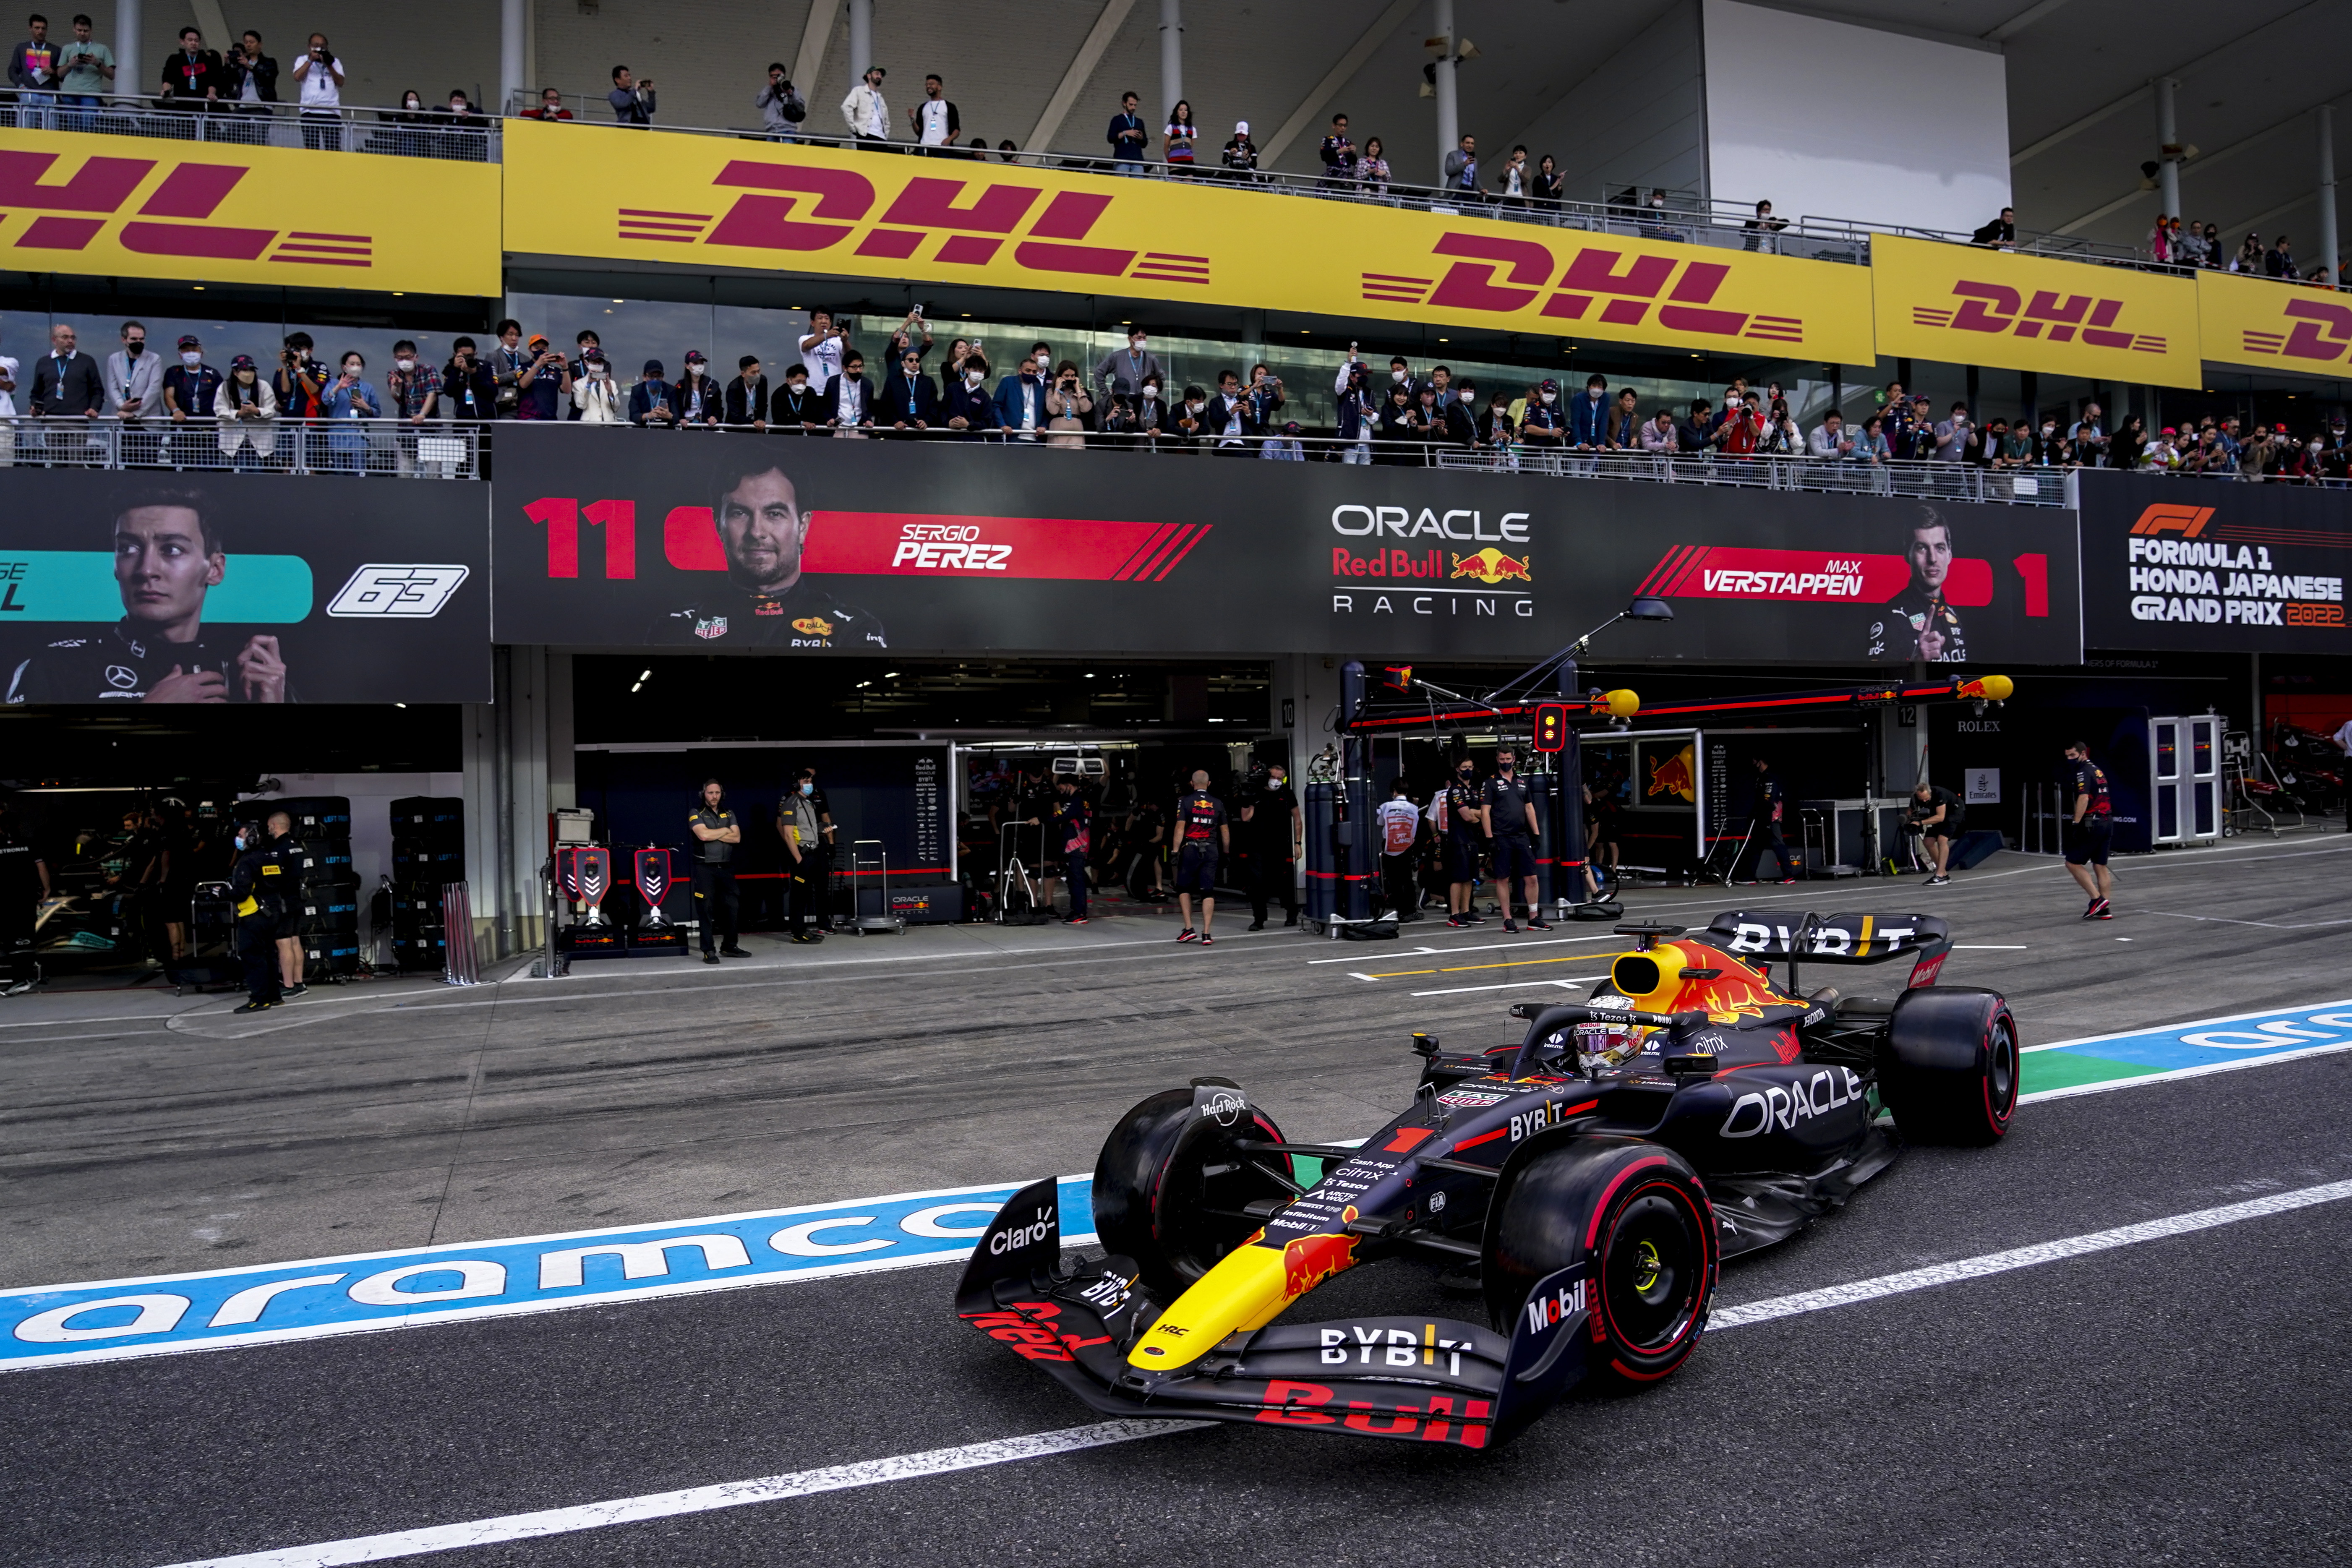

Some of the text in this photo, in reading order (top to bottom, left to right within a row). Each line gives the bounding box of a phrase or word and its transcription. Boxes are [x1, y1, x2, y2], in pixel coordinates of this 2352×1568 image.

[0, 150, 280, 261] HL
[704, 160, 1138, 277] DHL
[1427, 232, 1749, 336] DHL
[1950, 280, 2135, 349] DHL
[900, 524, 980, 542] SERGIO
[1332, 504, 1530, 543] ORACLE
[522, 498, 635, 579] 11
[892, 542, 1012, 570] PEREZ
[1332, 547, 1442, 578] Red Bull
[1825, 560, 1862, 574] MAX
[2129, 538, 2272, 570] FORMULA 1
[1704, 569, 1863, 596] VERSTAPPEN
[2013, 553, 2049, 617] 1
[2129, 567, 2343, 601] HONDA JAPANESE
[1333, 595, 1532, 617] RACING
[2131, 596, 2346, 627] GRAND PRIX 2022
[1859, 684, 1898, 693] ORACLE
[1283, 704, 1294, 723] 10
[1900, 706, 1915, 723] 12
[1958, 720, 2001, 732] ROLEX
[1910, 963, 1935, 986] Mobil
[1600, 1012, 1626, 1022] Tezos
[1803, 1007, 1826, 1028] HONDA
[1201, 1096, 1245, 1117] Hard Rock
[1455, 1091, 1502, 1100] TAG
[1719, 1066, 1862, 1138] ORACLE
[1511, 1099, 1563, 1142] BYBIT
[1383, 1127, 1435, 1153] 1
[1373, 1161, 1395, 1170] App
[1336, 1180, 1370, 1190] Tezos
[990, 1220, 1047, 1255] Claro
[1270, 1218, 1308, 1230] Mobil
[13, 1202, 1008, 1343] aramco
[1527, 1278, 1585, 1335] Mobil
[1157, 1324, 1190, 1336] HRC
[1321, 1324, 1472, 1376] BYBIT
[1255, 1379, 1490, 1449] Bull
